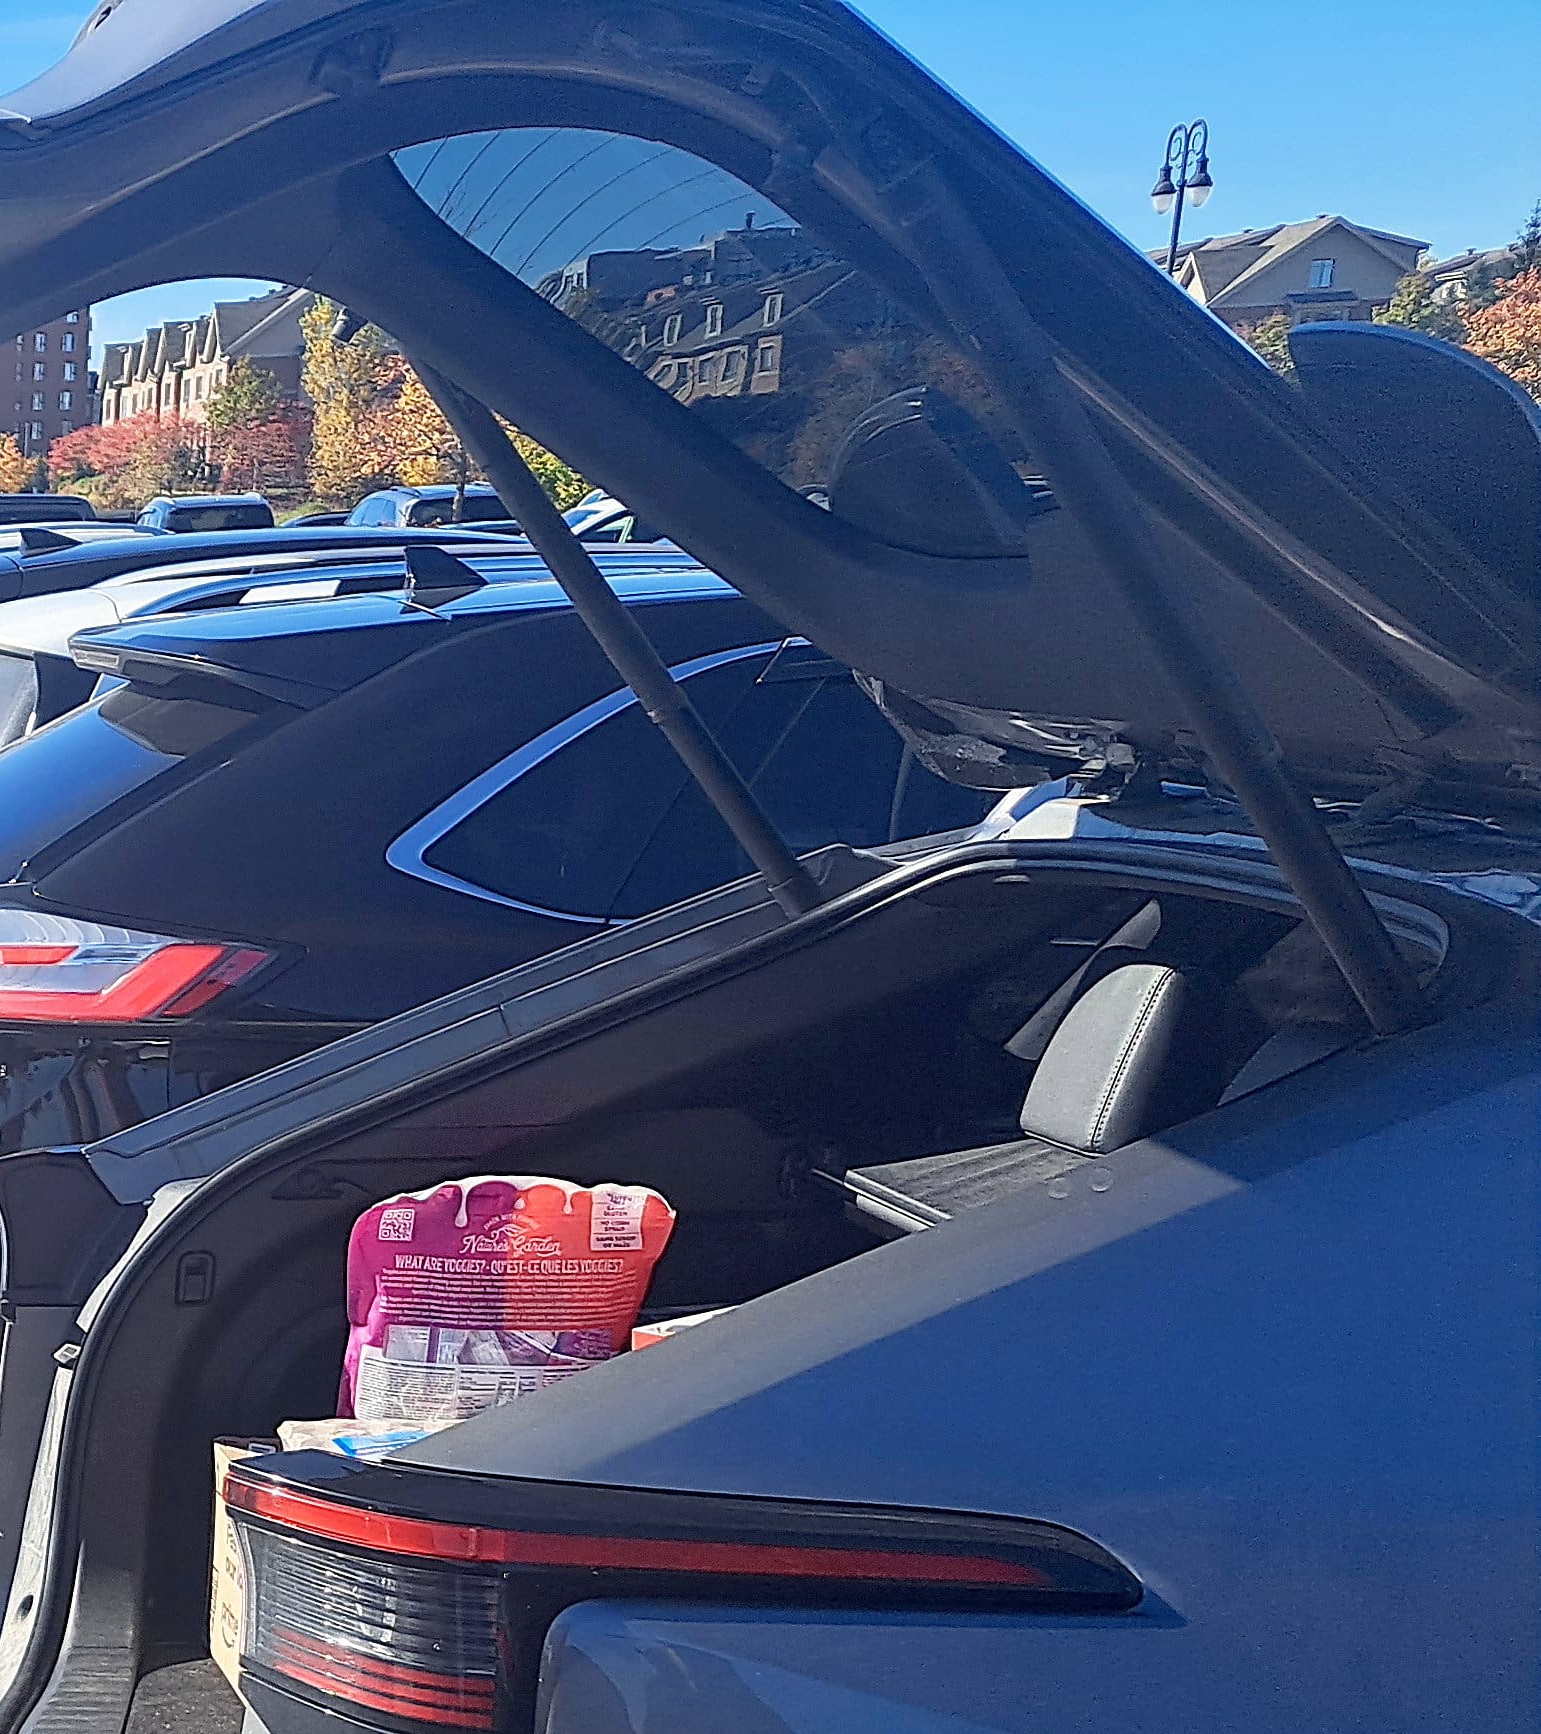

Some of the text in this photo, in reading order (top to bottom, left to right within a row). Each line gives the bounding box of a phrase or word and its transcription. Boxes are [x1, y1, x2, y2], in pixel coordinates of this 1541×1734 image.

[512, 1235, 562, 1257] Garden
[394, 1255, 422, 1269] WHAT
[423, 1256, 442, 1271] ARE
[540, 1259, 562, 1274] QUE
[562, 1259, 579, 1274] LES
